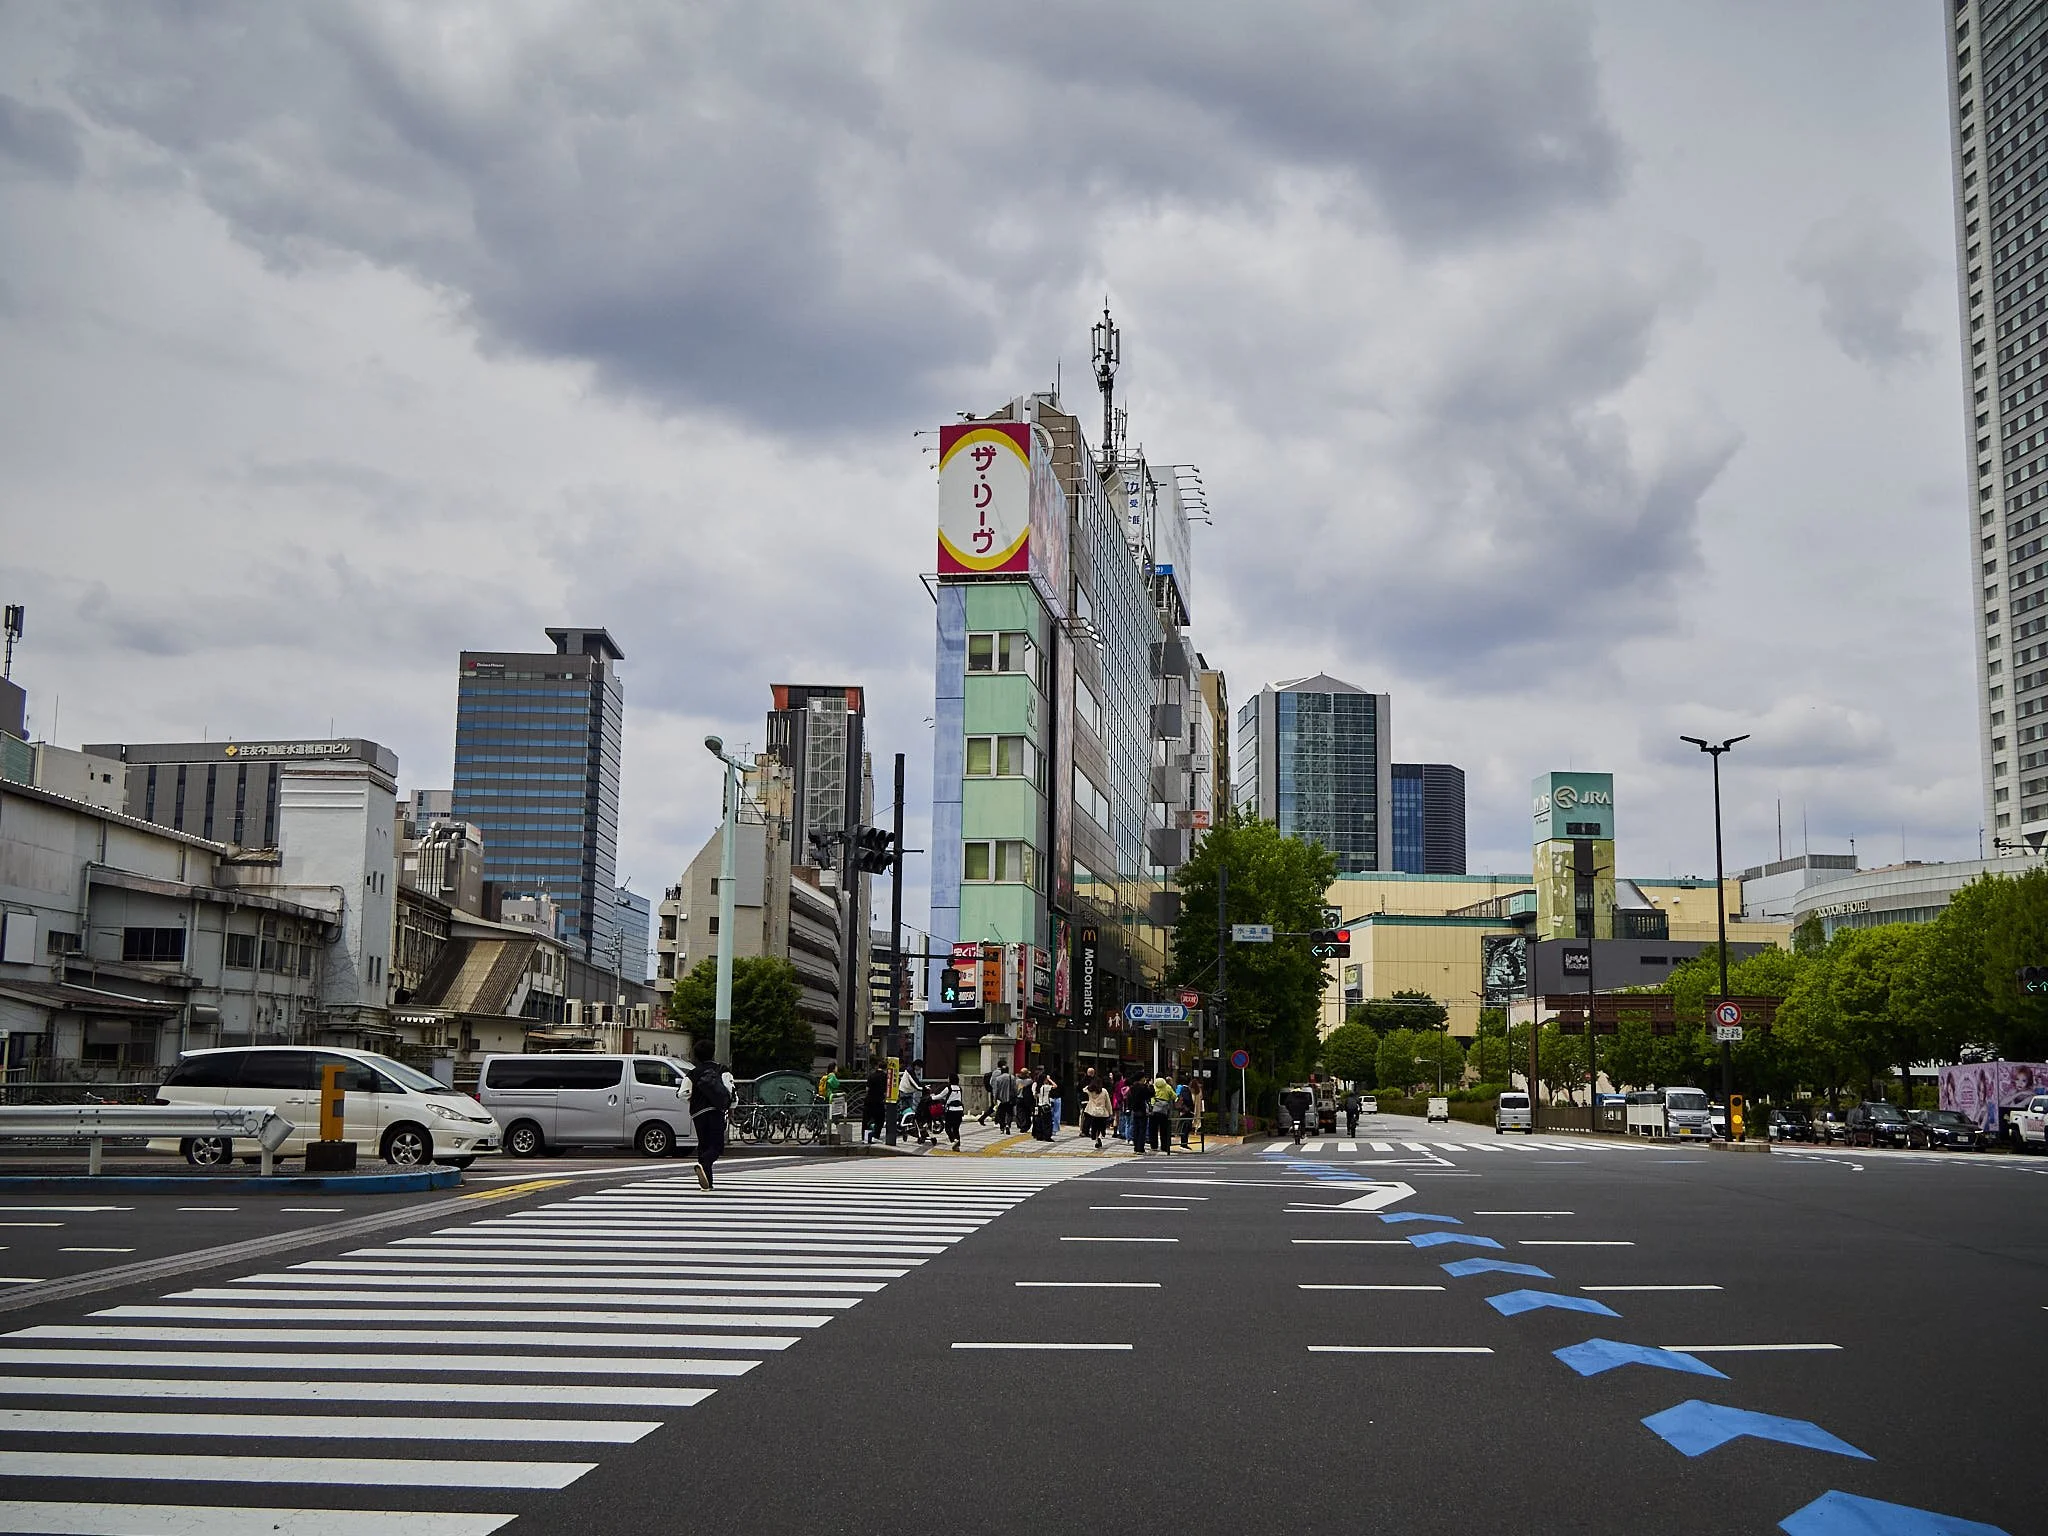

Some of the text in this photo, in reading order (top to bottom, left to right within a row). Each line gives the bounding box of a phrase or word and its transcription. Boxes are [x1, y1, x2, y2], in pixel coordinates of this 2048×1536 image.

[240, 743, 351, 756] 住友不動産水道橋西口ビル
[1580, 791, 1612, 804] JRA
[1847, 900, 1870, 913] HOTEL
[1083, 948, 1095, 1016] McDonald's
[1147, 1006, 1180, 1014] 白山通り
